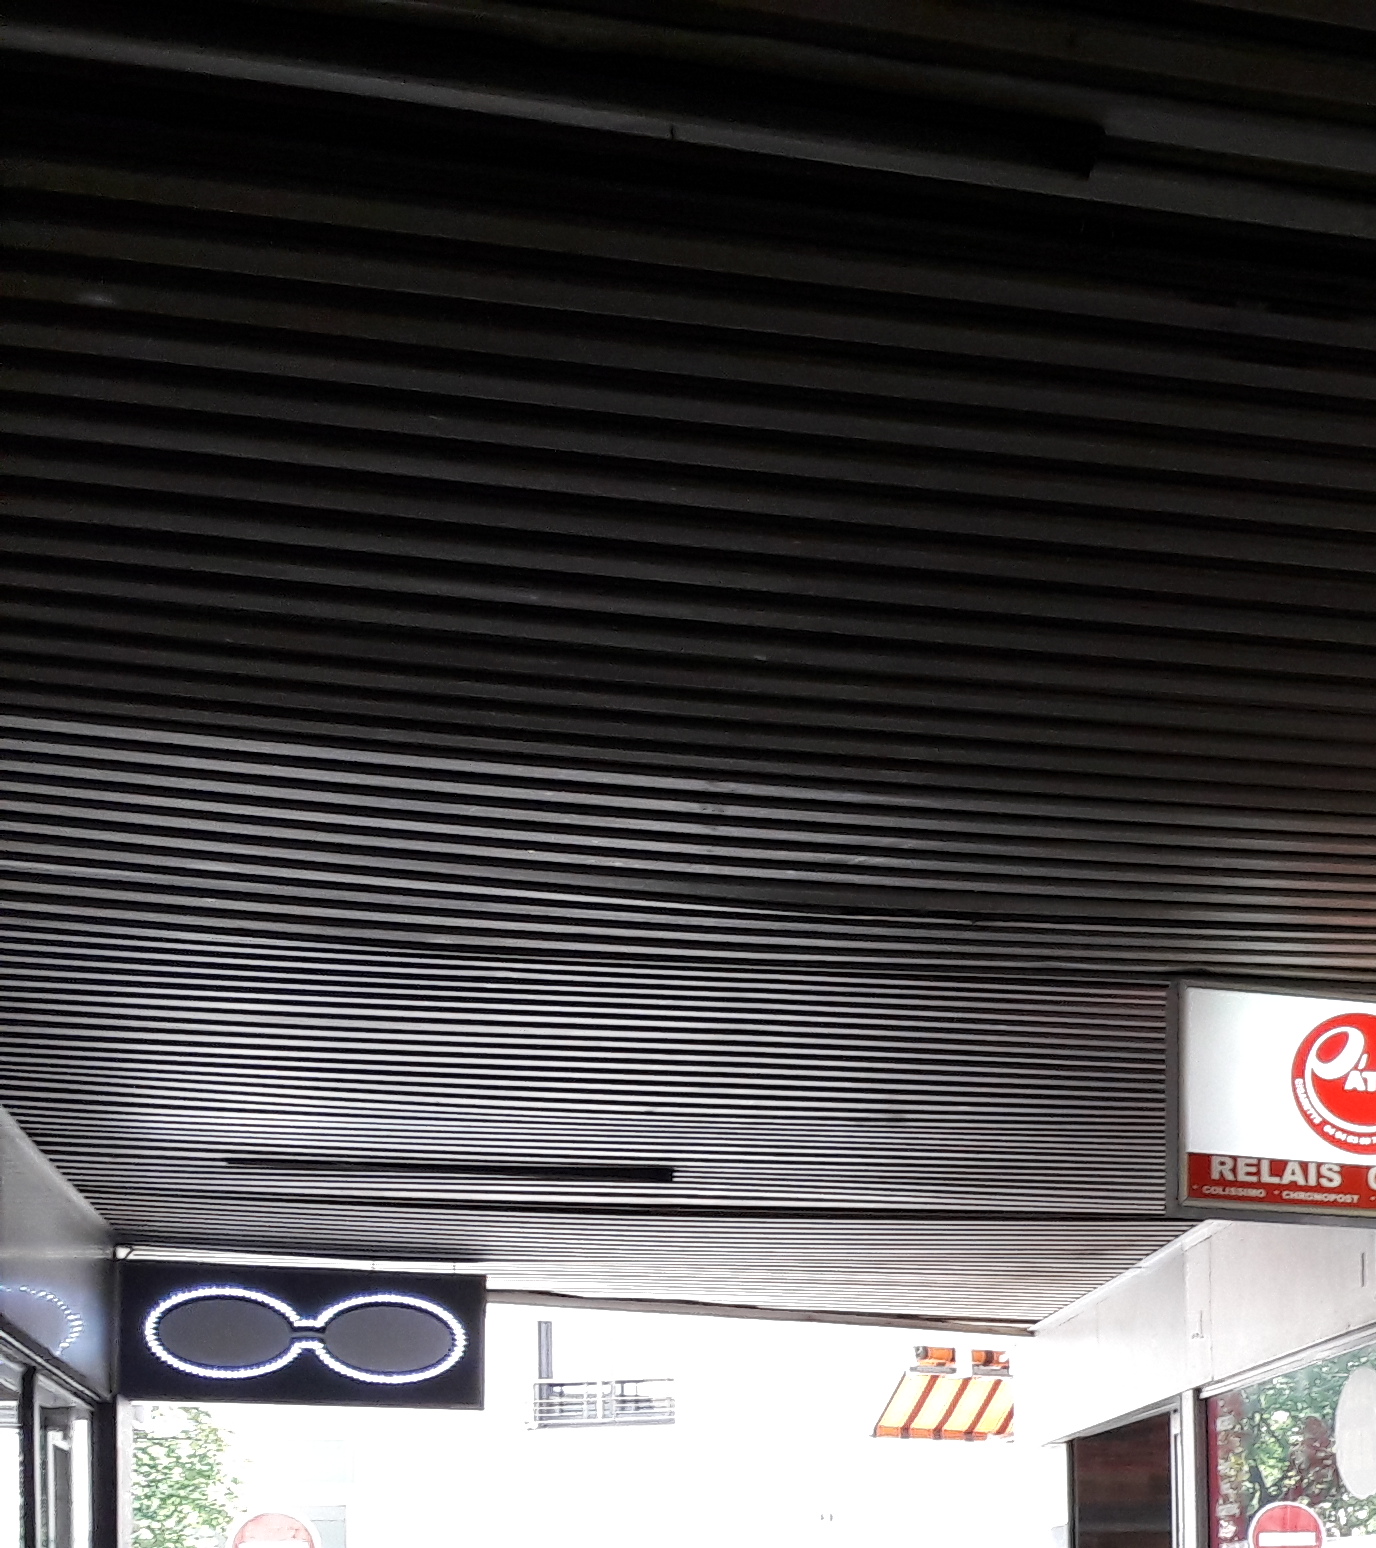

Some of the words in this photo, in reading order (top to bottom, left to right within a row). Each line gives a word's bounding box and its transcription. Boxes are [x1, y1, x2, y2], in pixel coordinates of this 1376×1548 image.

[1210, 1155, 1343, 1188] RELAIS
[1201, 1185, 1268, 1198] COLISSIMO
[1281, 1190, 1361, 1204] CHRONOPOST
